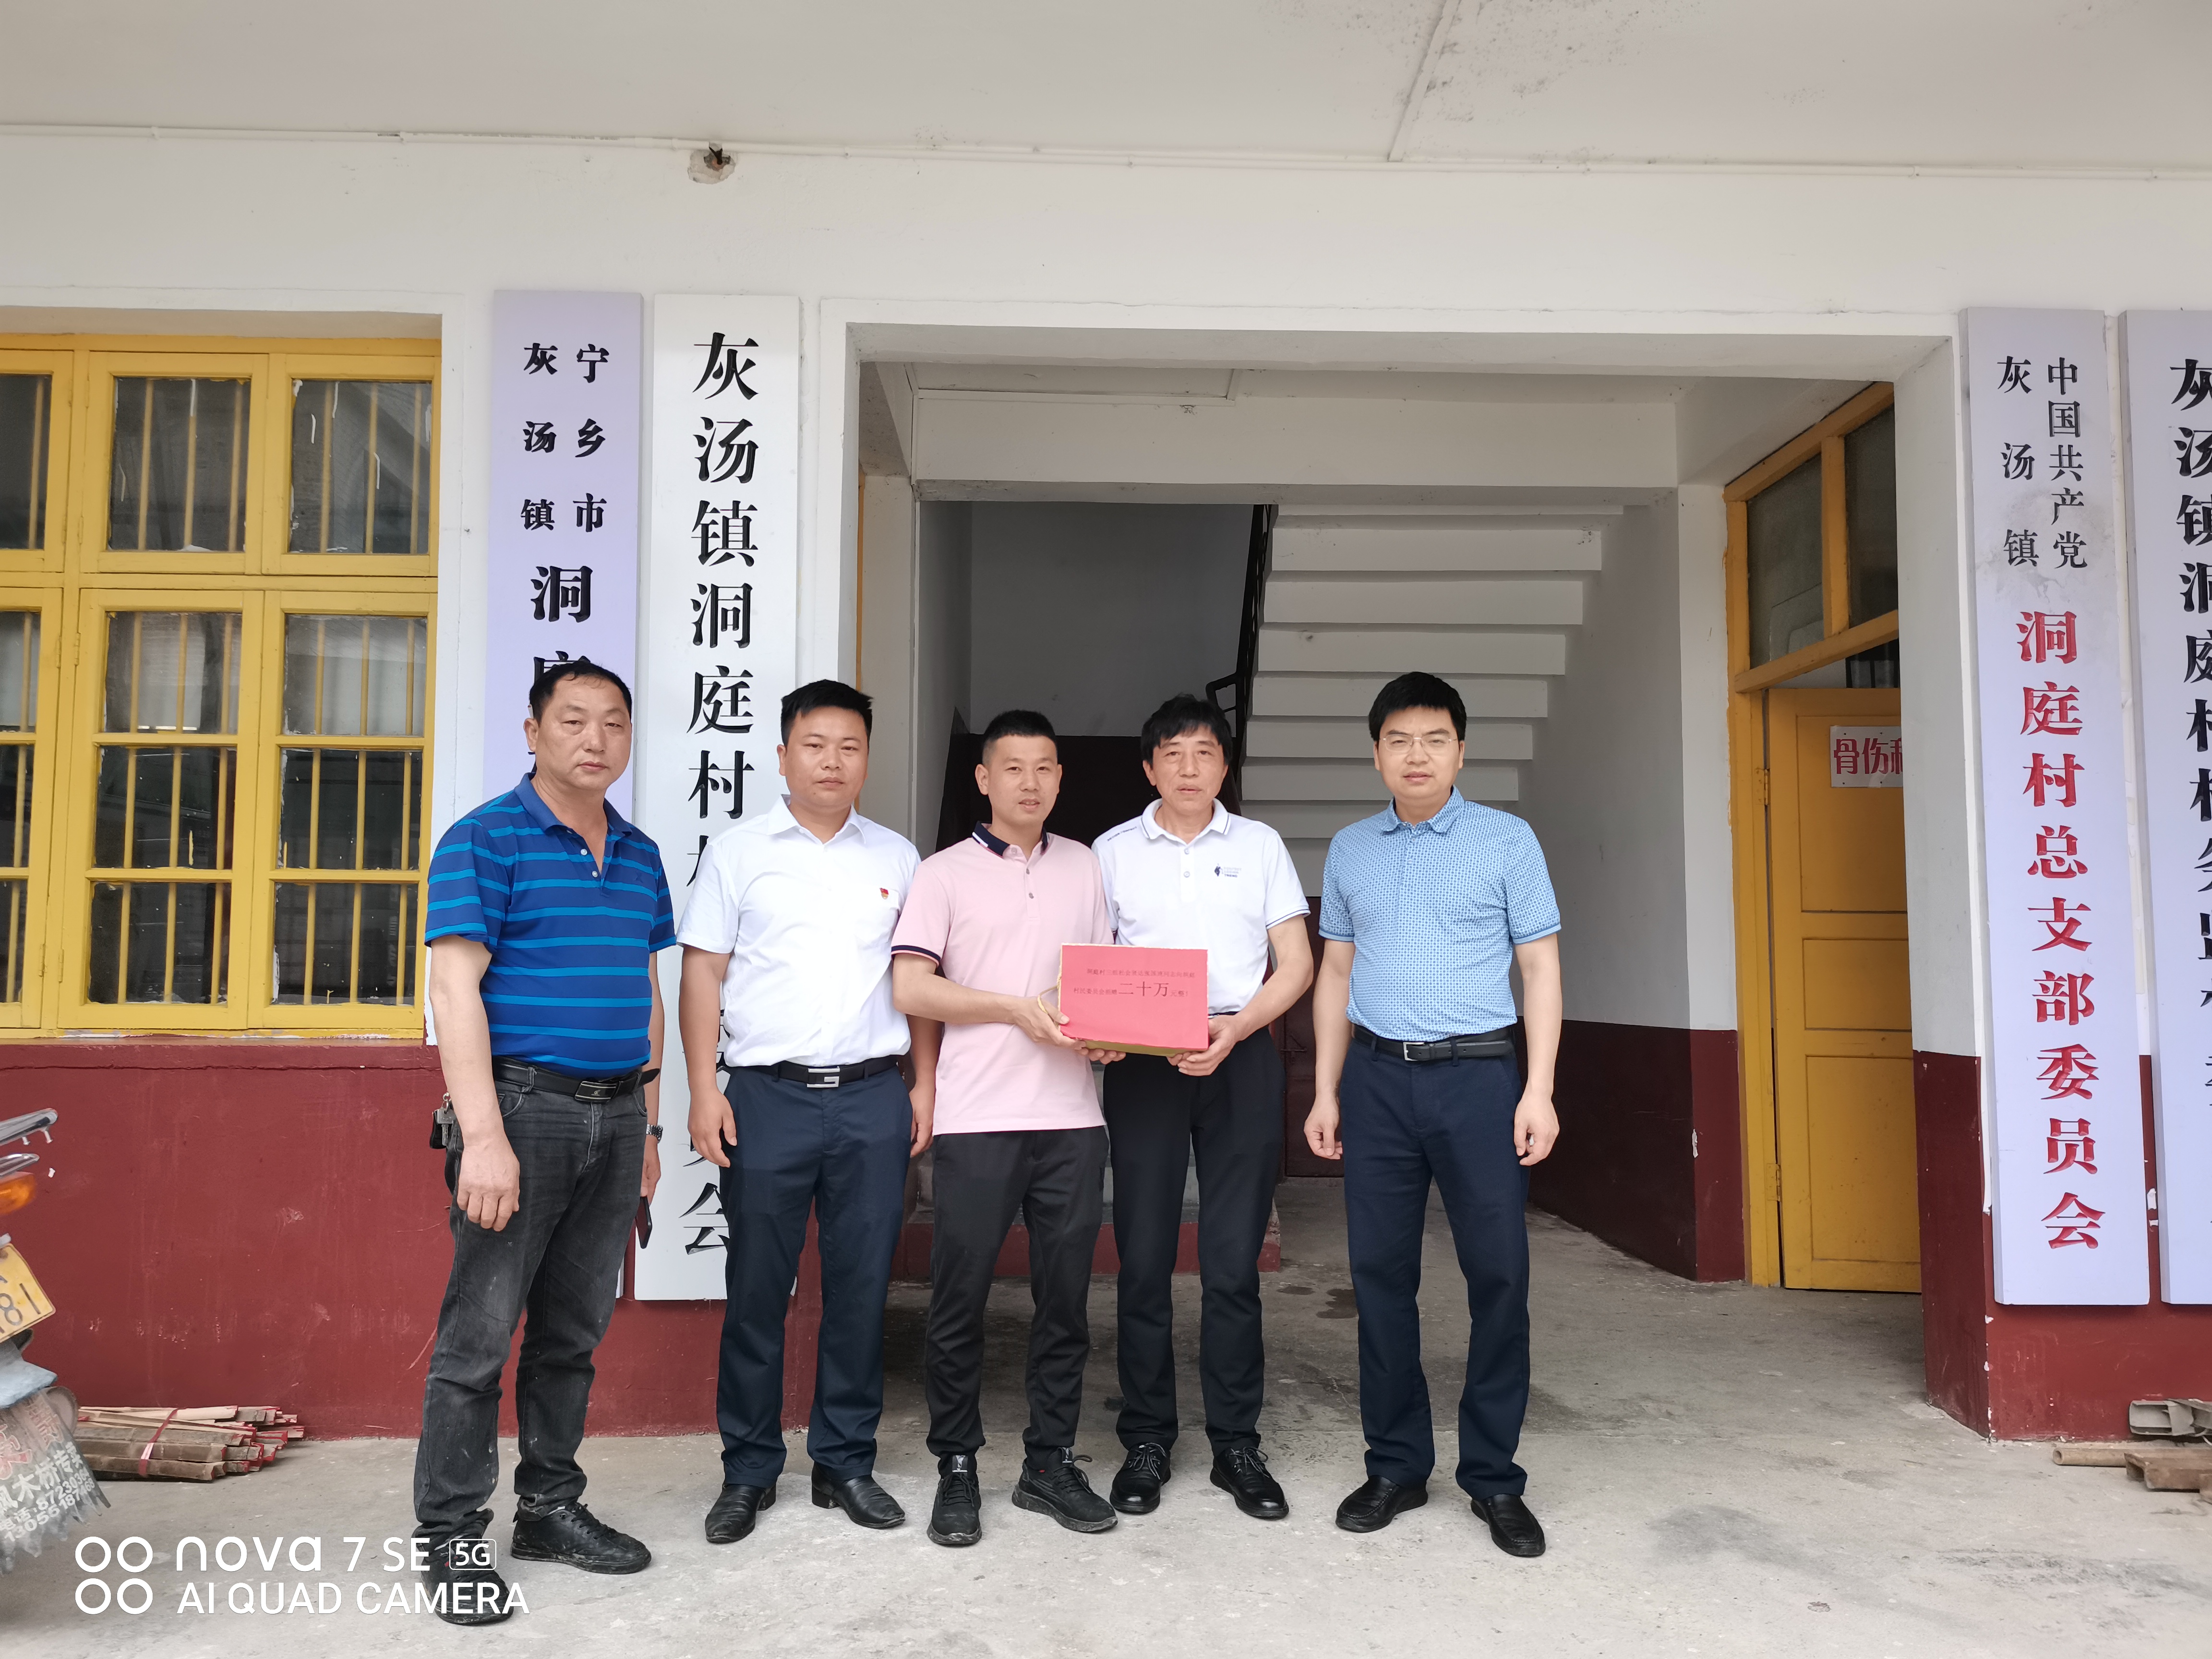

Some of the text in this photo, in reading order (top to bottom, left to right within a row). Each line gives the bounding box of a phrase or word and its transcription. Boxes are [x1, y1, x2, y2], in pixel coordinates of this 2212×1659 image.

[520, 342, 558, 531] 灰汤镇
[572, 343, 610, 533] 宁乡市
[1997, 355, 2039, 567] 灰汤镇
[2047, 357, 2088, 568] 中国共产党
[2017, 611, 2105, 1249] 洞庭村总支部委员会
